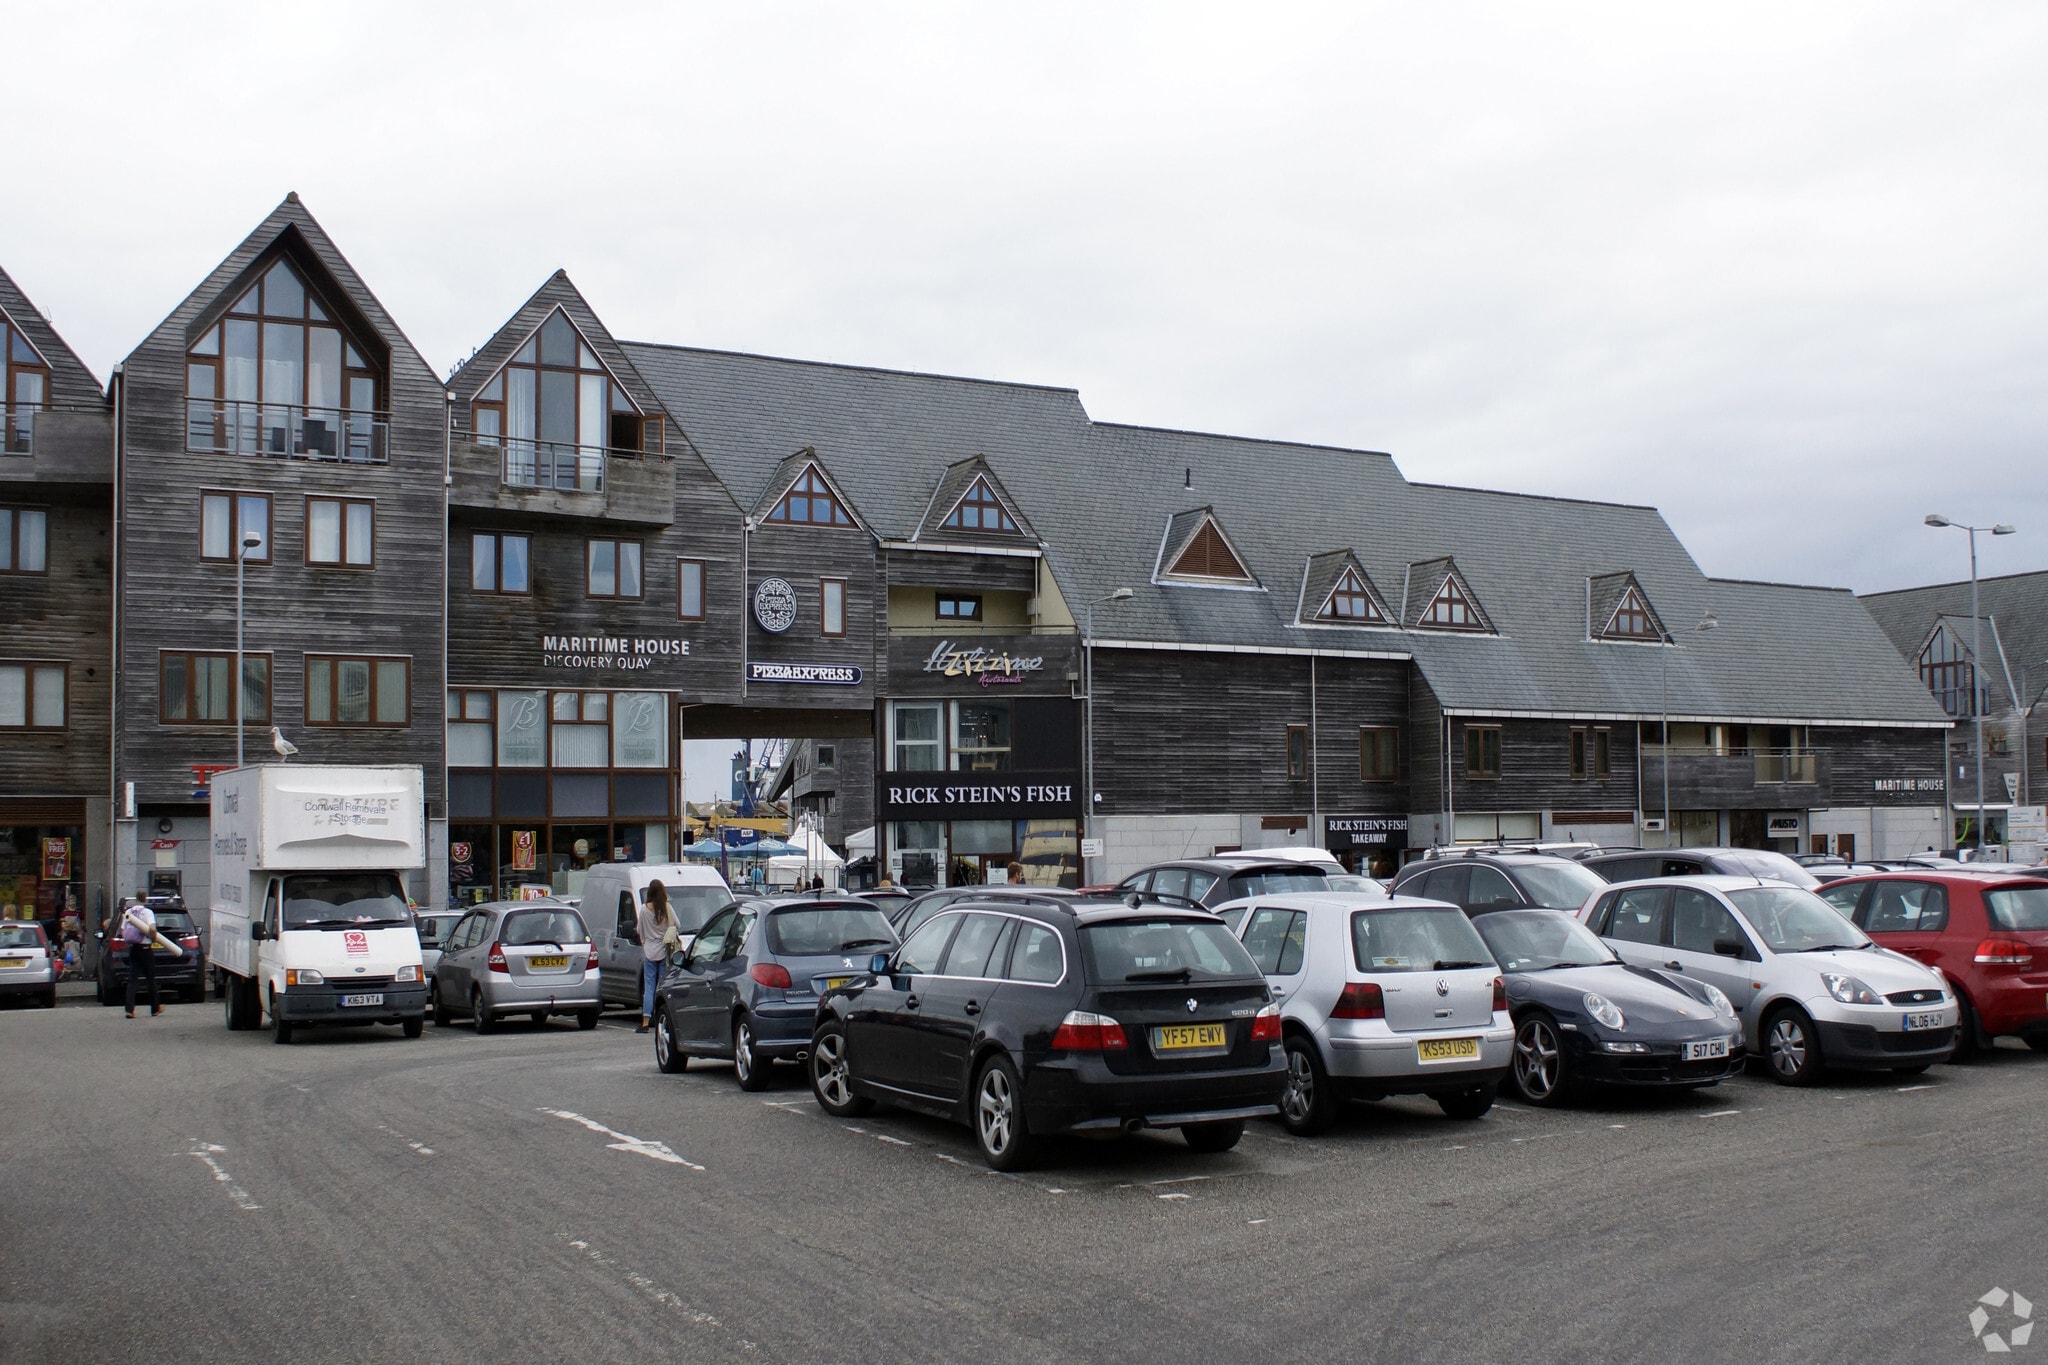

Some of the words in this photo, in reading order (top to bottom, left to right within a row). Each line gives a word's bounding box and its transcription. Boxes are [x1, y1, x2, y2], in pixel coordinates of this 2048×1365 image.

[759, 603, 793, 611] EXPRESS
[543, 636, 629, 654] MARITIME
[634, 639, 690, 656] HOUSE
[543, 654, 613, 668] DISCOVERY
[617, 657, 652, 670] QUAY
[1875, 779, 1916, 791] MARITIME
[1917, 779, 1944, 791] HOUSE
[888, 787, 940, 804] RICK
[944, 785, 1021, 804] STEIN'S
[1026, 785, 1072, 802] FISH
[1329, 820, 1352, 831] RICK
[1352, 819, 1387, 831] STEIN'S
[1387, 820, 1408, 830] FISH
[1351, 833, 1388, 844] TAKEAWAY
[48, 845, 66, 853] FREE
[366, 995, 381, 1004] VTA
[1162, 1028, 1196, 1045] YF57
[1200, 1026, 1222, 1043] EWY
[1424, 1041, 1452, 1057] KS53
[1454, 1040, 1474, 1055] USD
[1710, 1041, 1725, 1056] CHU
